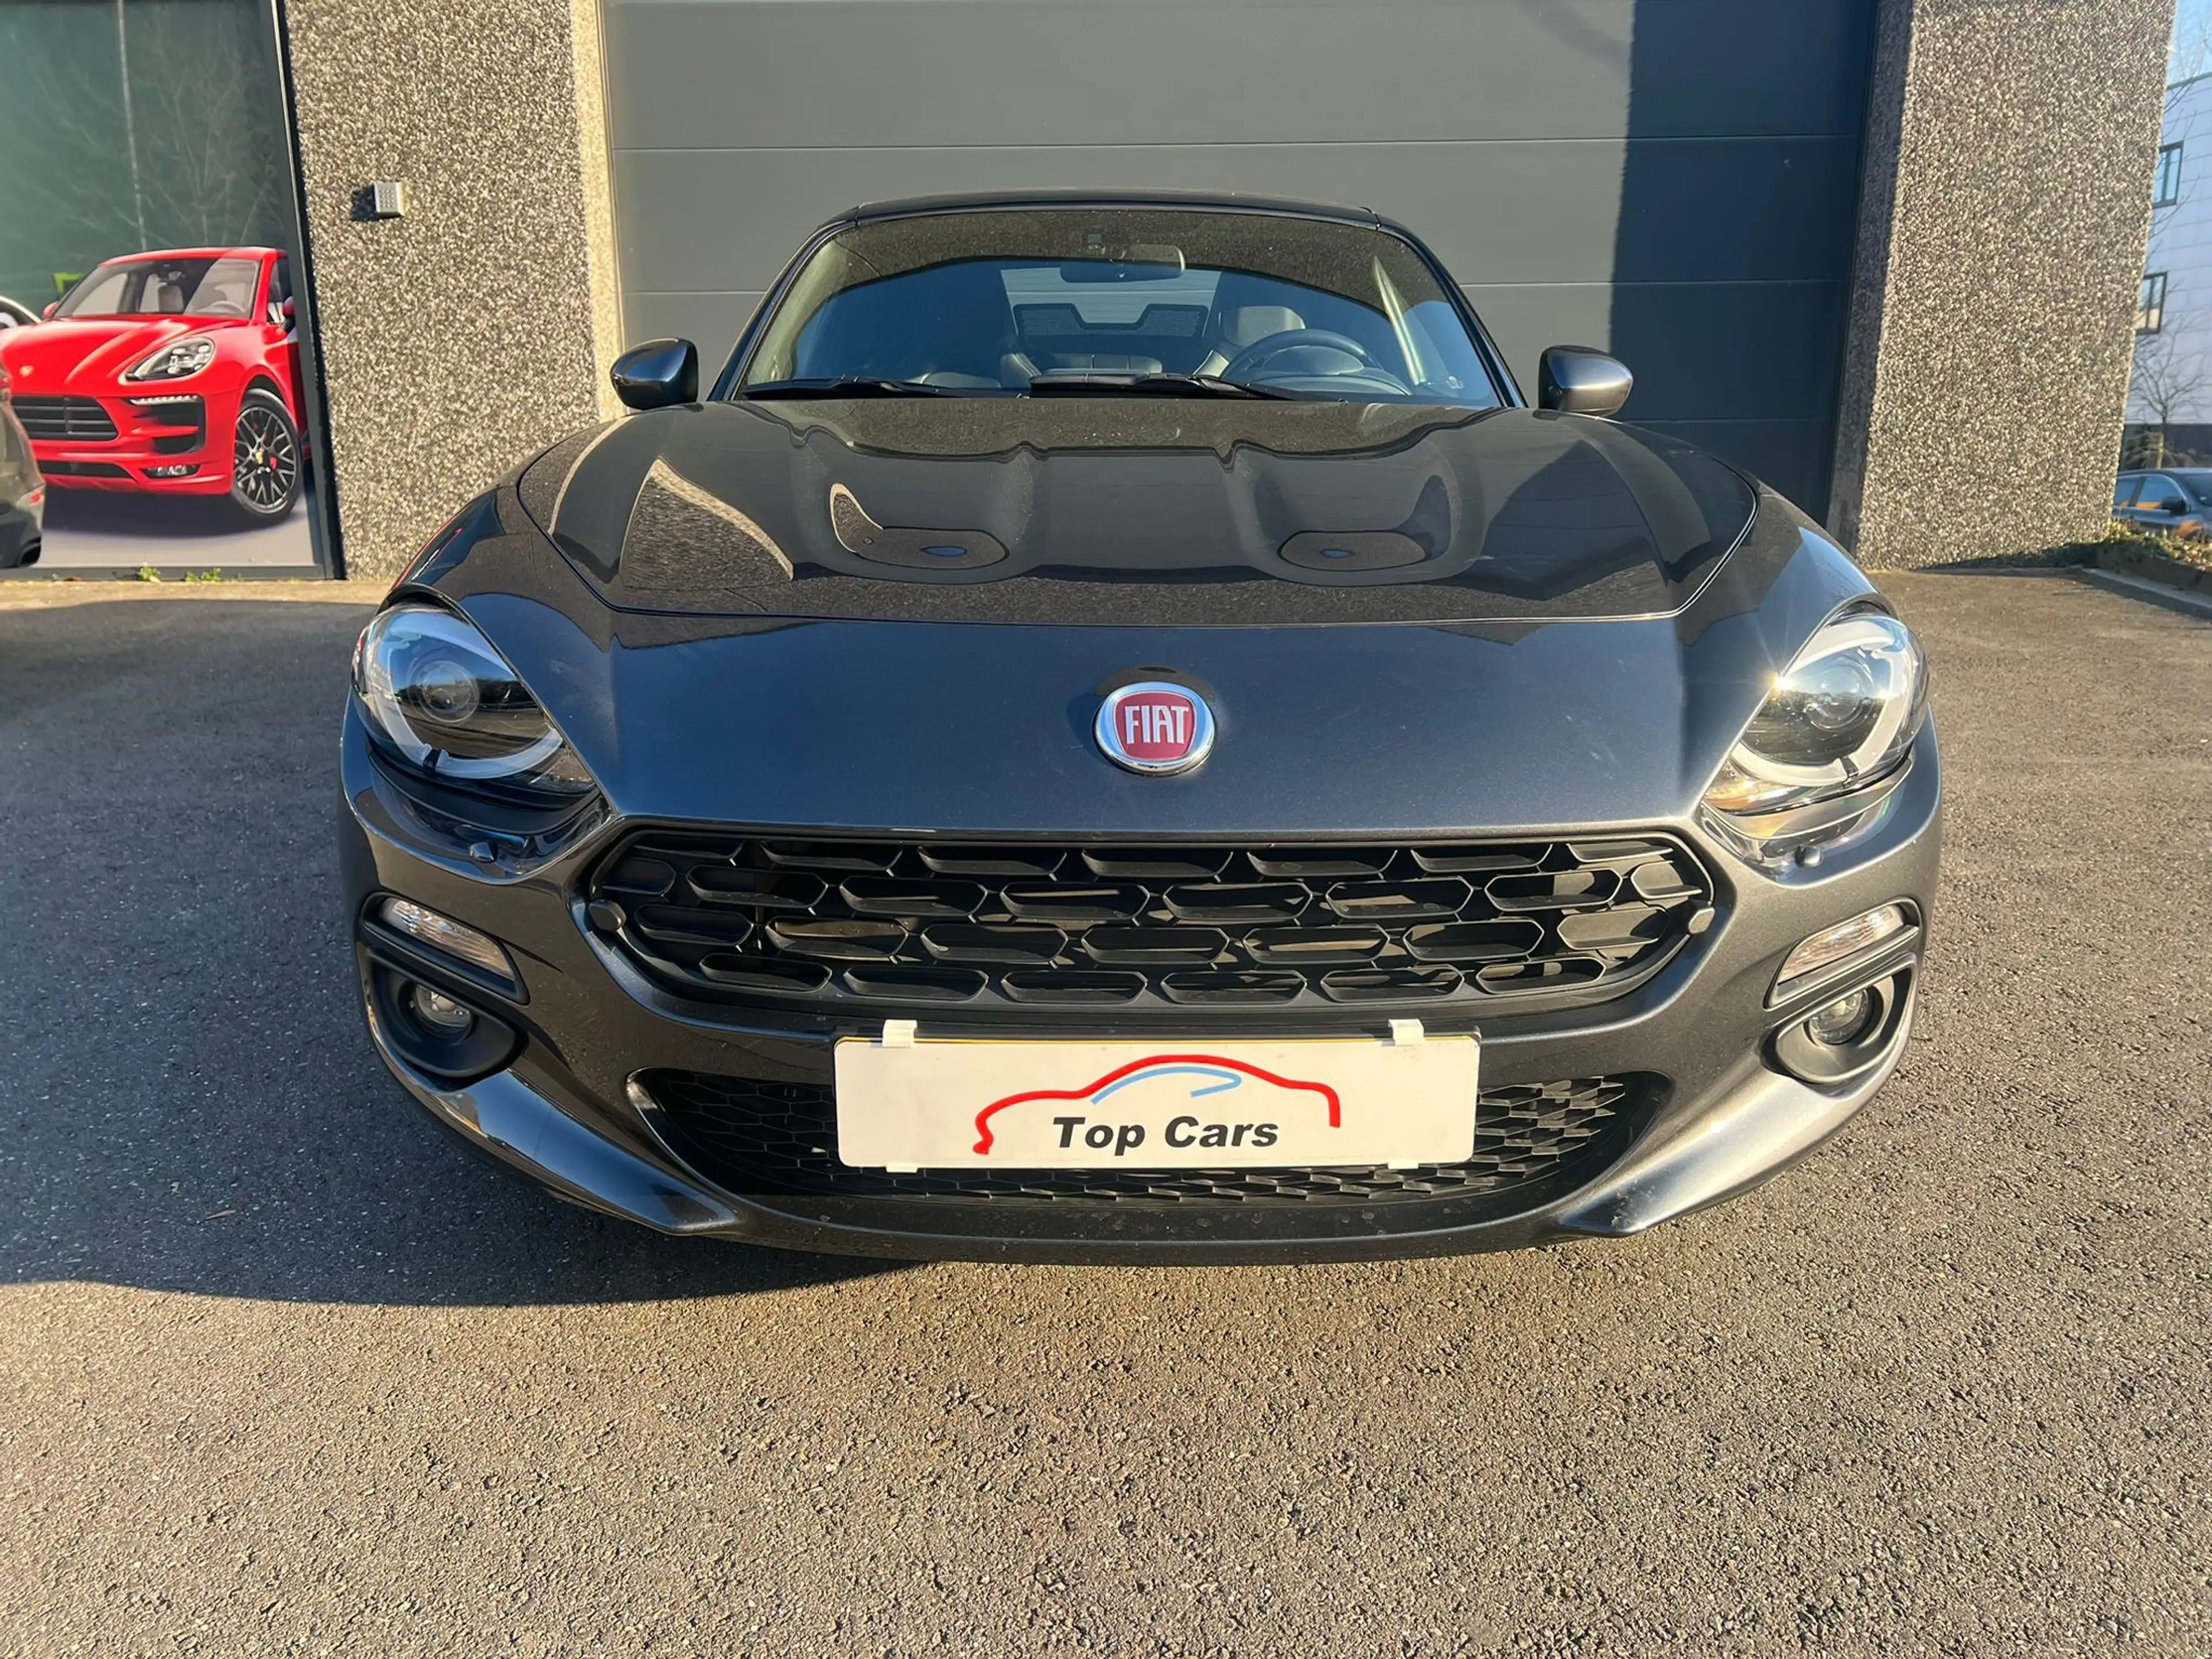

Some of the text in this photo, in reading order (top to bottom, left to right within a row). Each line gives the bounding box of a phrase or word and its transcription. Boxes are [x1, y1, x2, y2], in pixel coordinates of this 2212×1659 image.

[1124, 705, 1189, 745] FIAT
[1052, 1115, 1278, 1156] Top Cars
